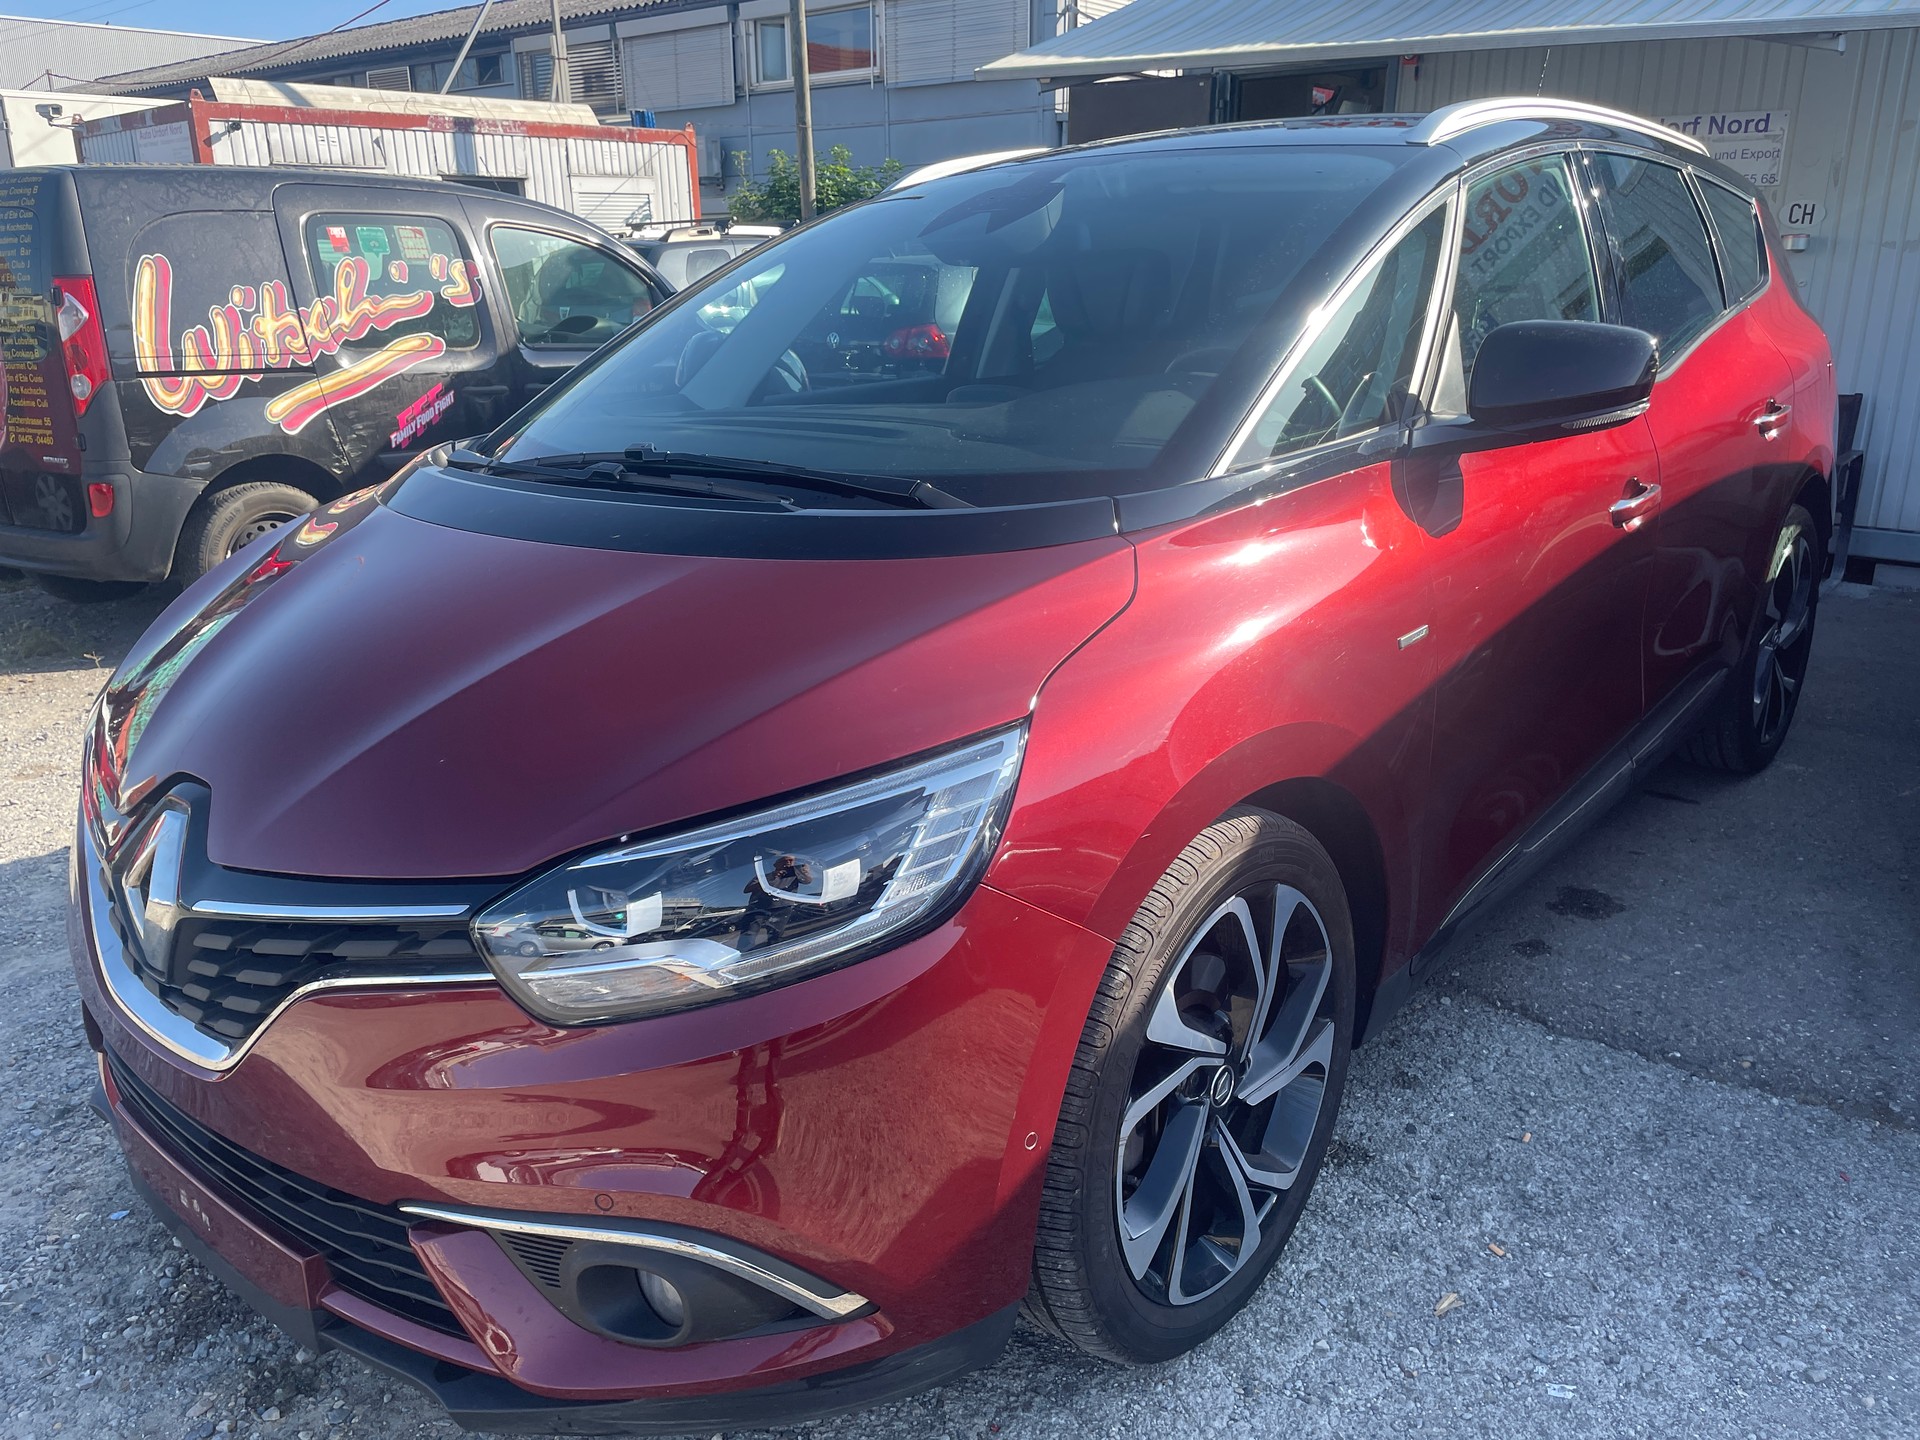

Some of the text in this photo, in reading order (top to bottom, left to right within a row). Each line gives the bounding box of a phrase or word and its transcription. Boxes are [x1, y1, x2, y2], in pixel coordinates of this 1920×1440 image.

[1660, 112, 1771, 136] orf Nord
[1714, 148, 1780, 162] und Export
[1788, 203, 1816, 225] CH
[20, 247, 32, 256] Bar
[390, 390, 455, 449] FAMILY FOOD FIGHT
